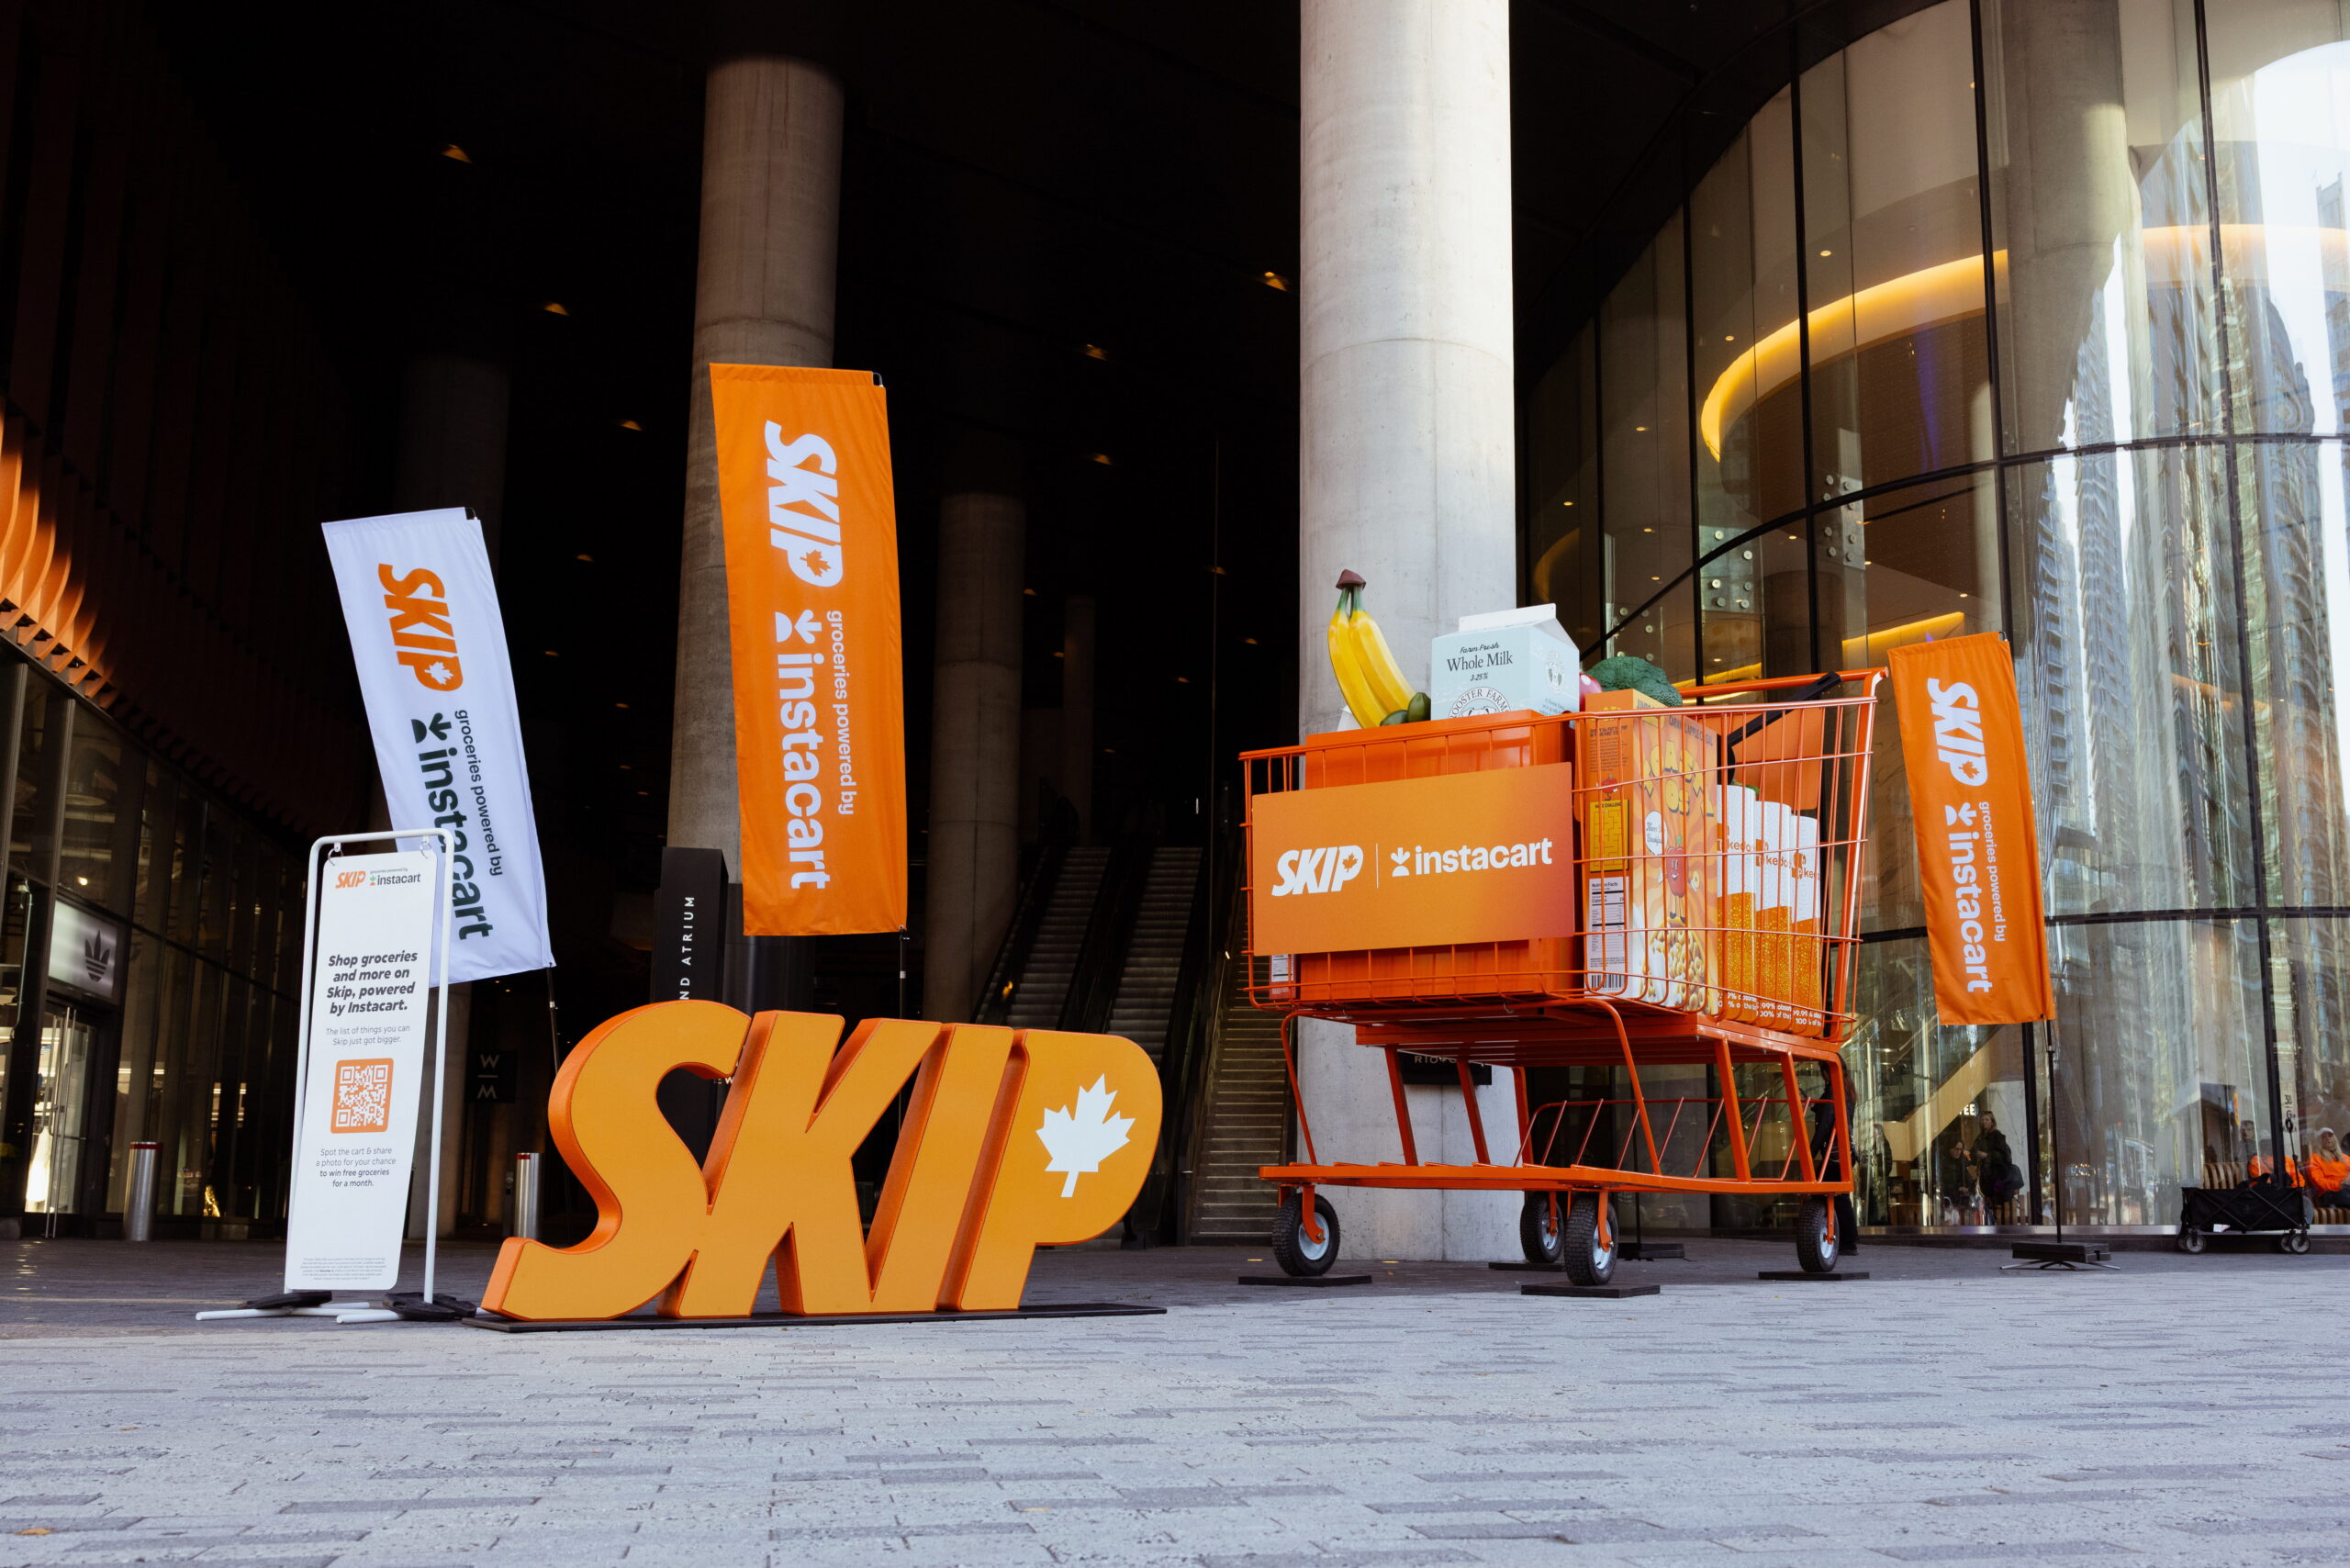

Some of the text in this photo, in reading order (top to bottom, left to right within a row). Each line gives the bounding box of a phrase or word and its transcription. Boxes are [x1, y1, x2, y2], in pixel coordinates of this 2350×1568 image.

[765, 420, 843, 587] SKIP
[378, 563, 463, 691] SKIP
[1447, 651, 1513, 672] Whole Milk
[827, 610, 857, 815] groceries powered by
[1927, 678, 1987, 787] SKIP
[778, 653, 831, 890] instacart
[454, 710, 503, 876] groceries powered by
[419, 747, 493, 940] instacart
[1271, 837, 1552, 896] SKIP instacart
[1979, 801, 2007, 942] groceries powered by
[335, 870, 366, 889] SKIP
[377, 873, 420, 886] instacart
[1948, 831, 1993, 992] instacart
[681, 897, 695, 966] ATRIUM
[329, 950, 418, 968] Shop groceries
[333, 969, 409, 982] and more on
[327, 981, 416, 1000] Skip, powered
[679, 977, 690, 1000] ND
[330, 999, 408, 1016] by Instacart.
[352, 1025, 359, 1035] of
[361, 1025, 382, 1035] things
[383, 1026, 396, 1035] you
[332, 1036, 401, 1046] Skip just got bigger.
[480, 1054, 499, 1069] W
[477, 1084, 497, 1099] M
[320, 1147, 392, 1157] Spot the cart & share
[321, 1159, 341, 1167] photo
[343, 1158, 353, 1166] for
[354, 1159, 371, 1167] your
[372, 1157, 396, 1165] chance
[480, 999, 1164, 1321] SKIP
[329, 1169, 341, 1177] win
[358, 1168, 389, 1178] groceries
[332, 1179, 342, 1187] for
[349, 1179, 374, 1187] month.
